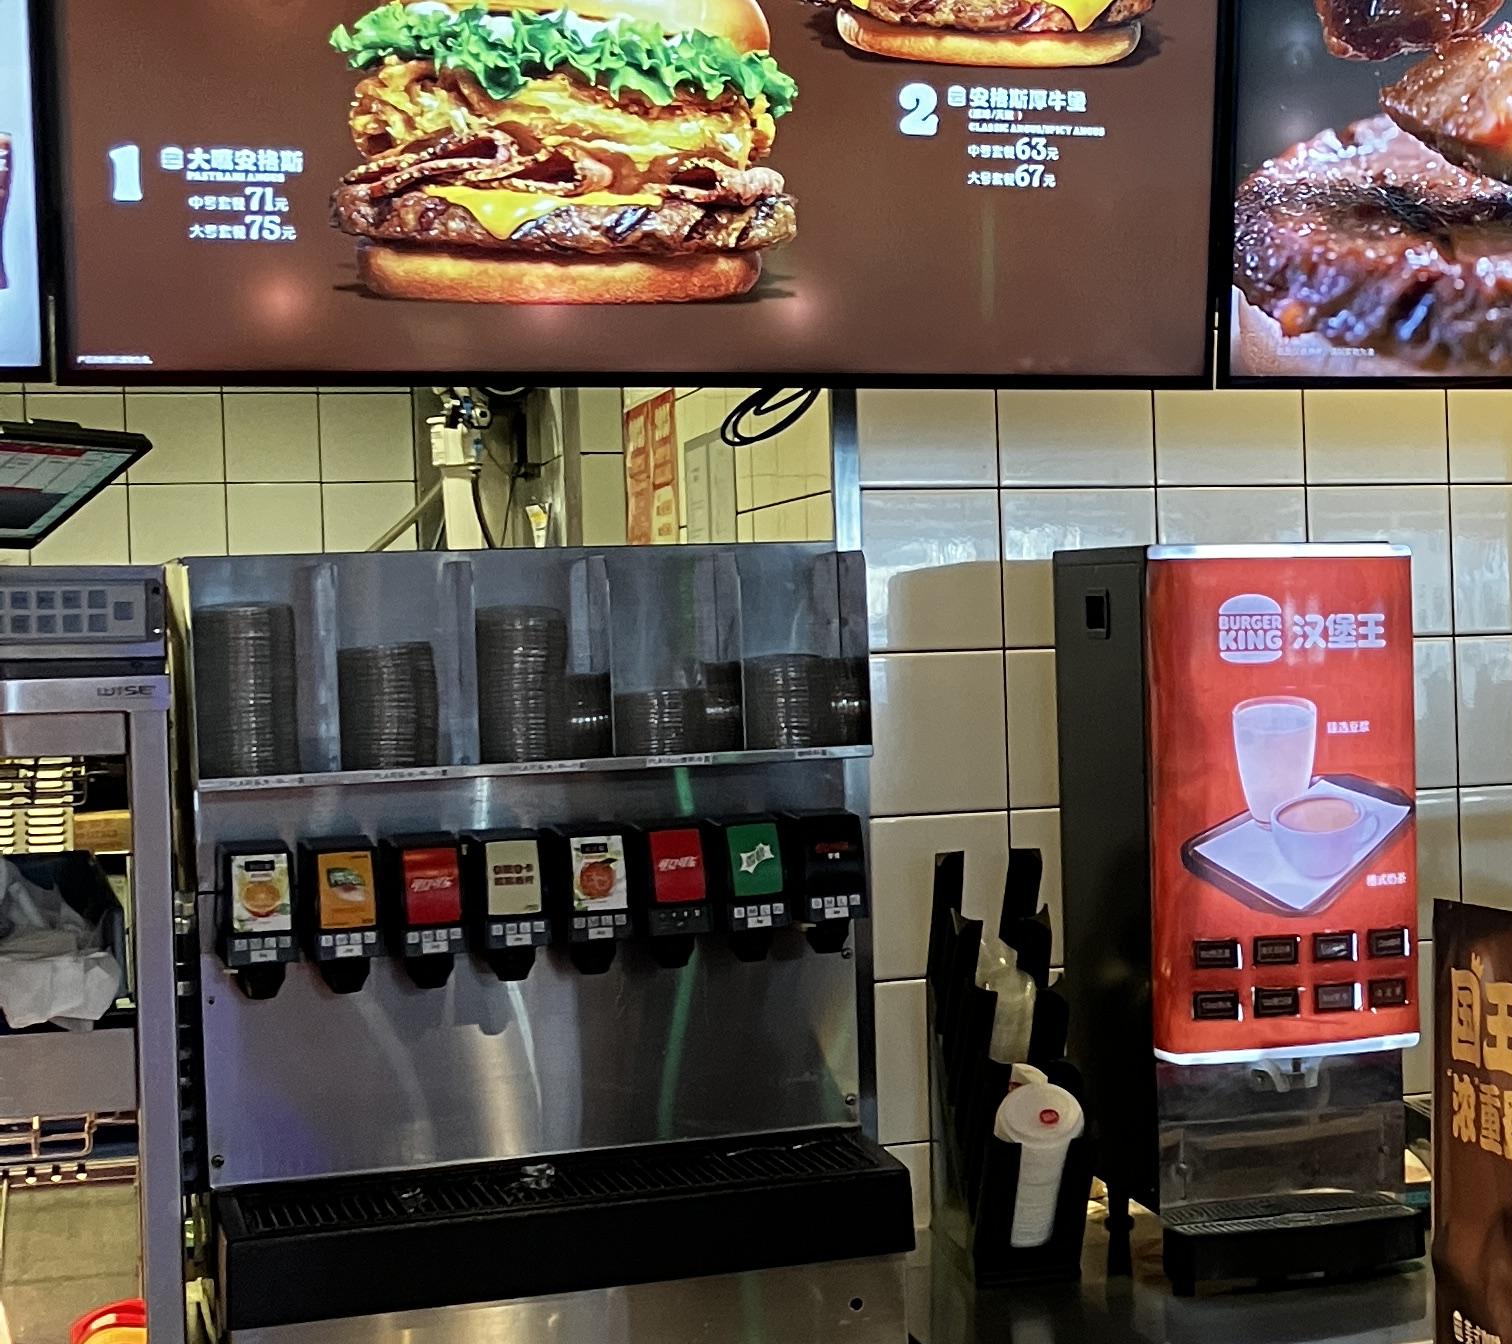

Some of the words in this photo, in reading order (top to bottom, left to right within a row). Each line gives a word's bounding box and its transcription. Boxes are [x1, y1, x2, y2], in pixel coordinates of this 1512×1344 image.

[899, 82, 939, 136] 2
[109, 145, 143, 201] 1
[1218, 615, 1282, 630] BURGER
[1219, 630, 1283, 651] KING
[1292, 613, 1387, 649] 汉堡王
